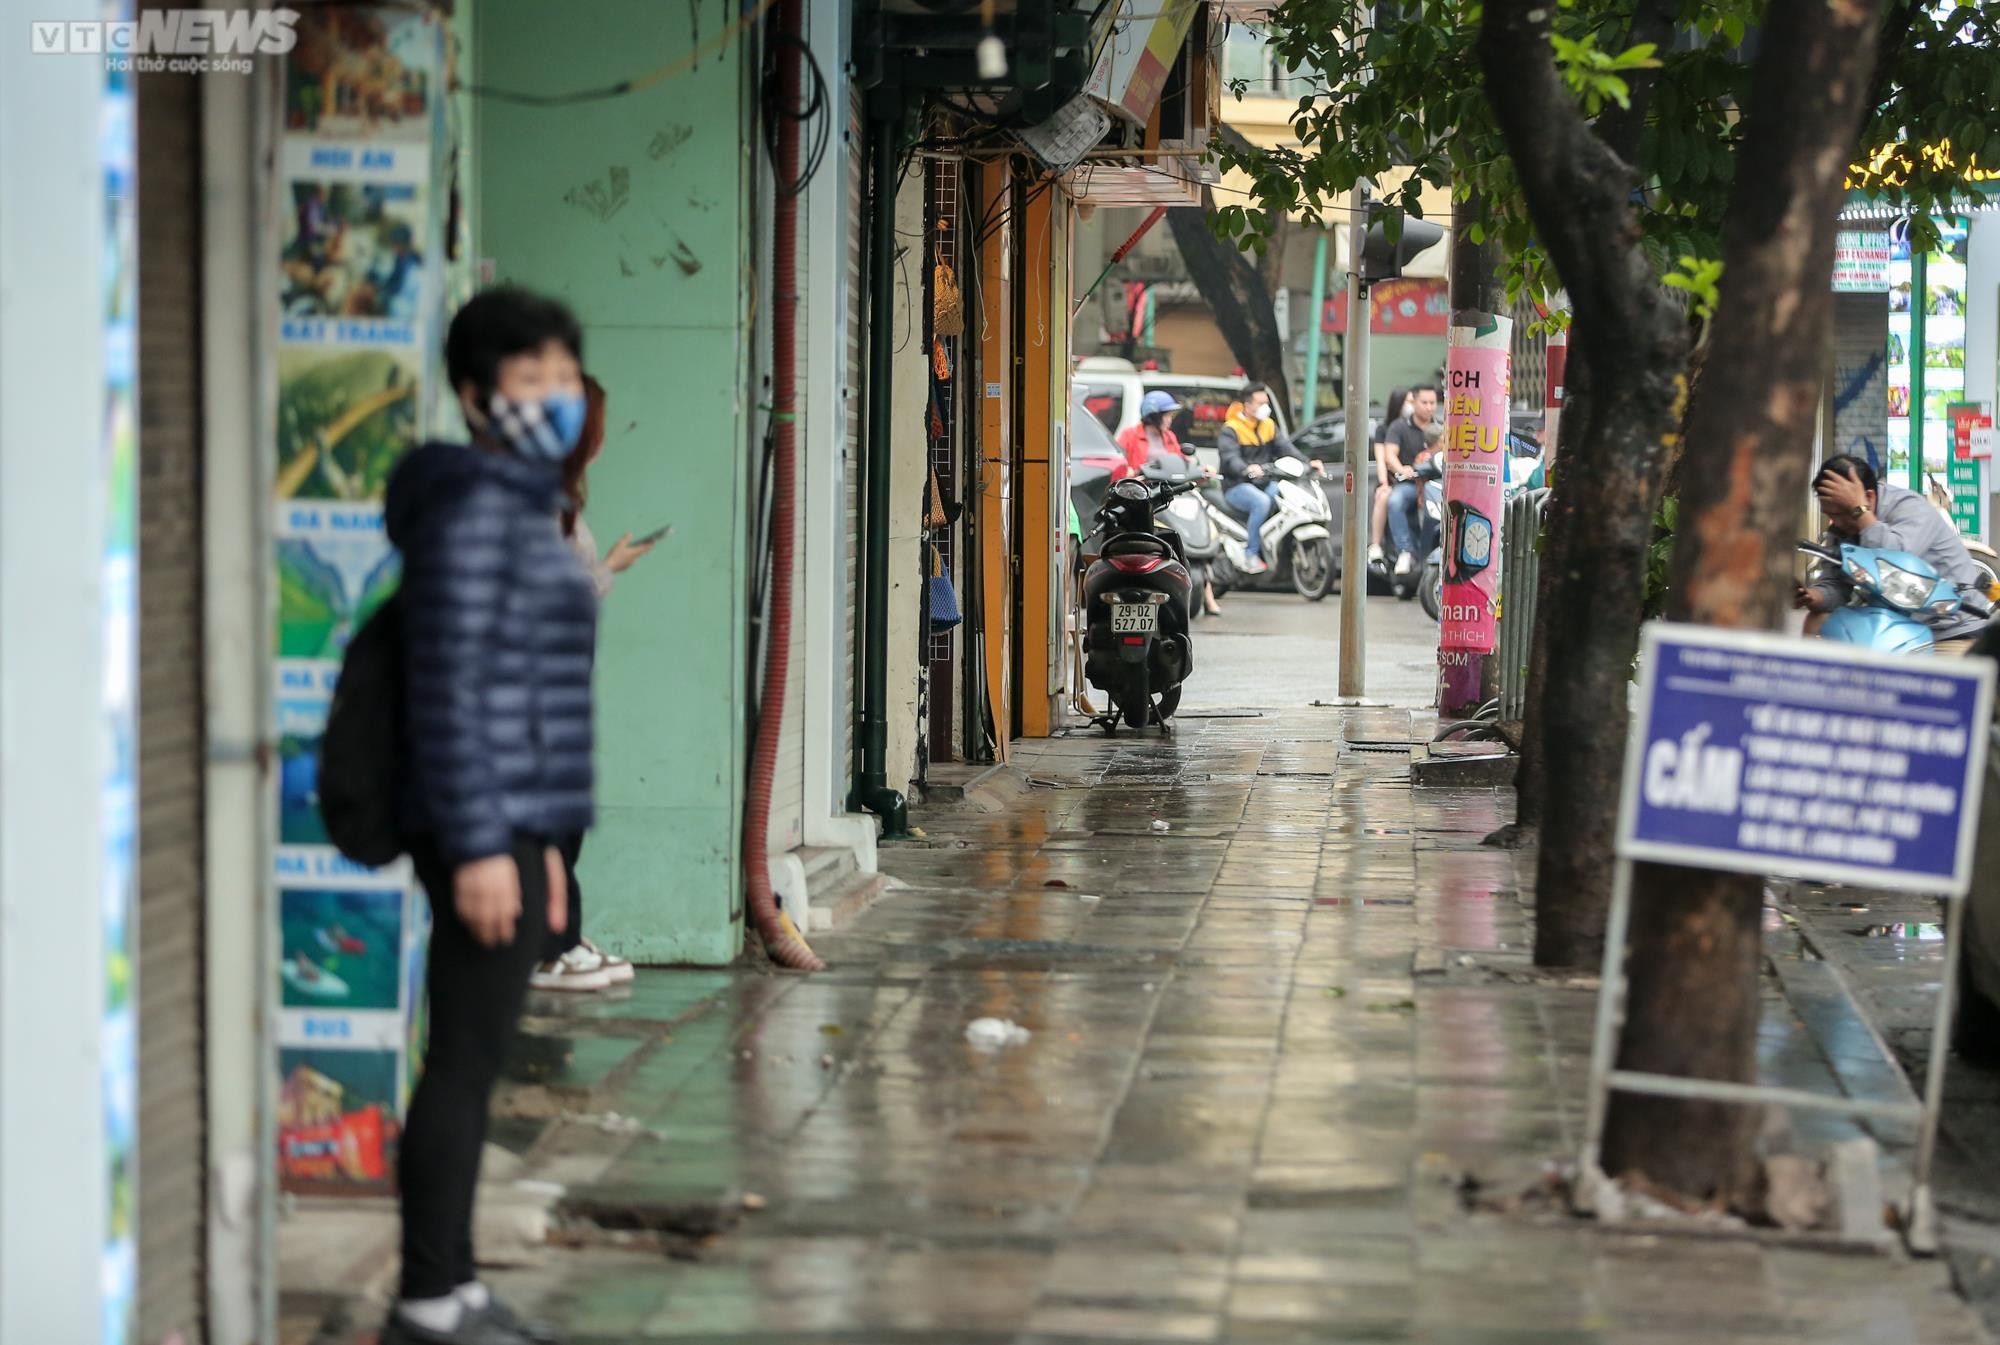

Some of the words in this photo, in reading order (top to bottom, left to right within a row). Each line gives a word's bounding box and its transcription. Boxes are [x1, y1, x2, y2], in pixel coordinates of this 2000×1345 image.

[1449, 370, 1480, 388] CH
[1114, 619, 1154, 631] 527.07
[1440, 651, 1468, 667] SOM
